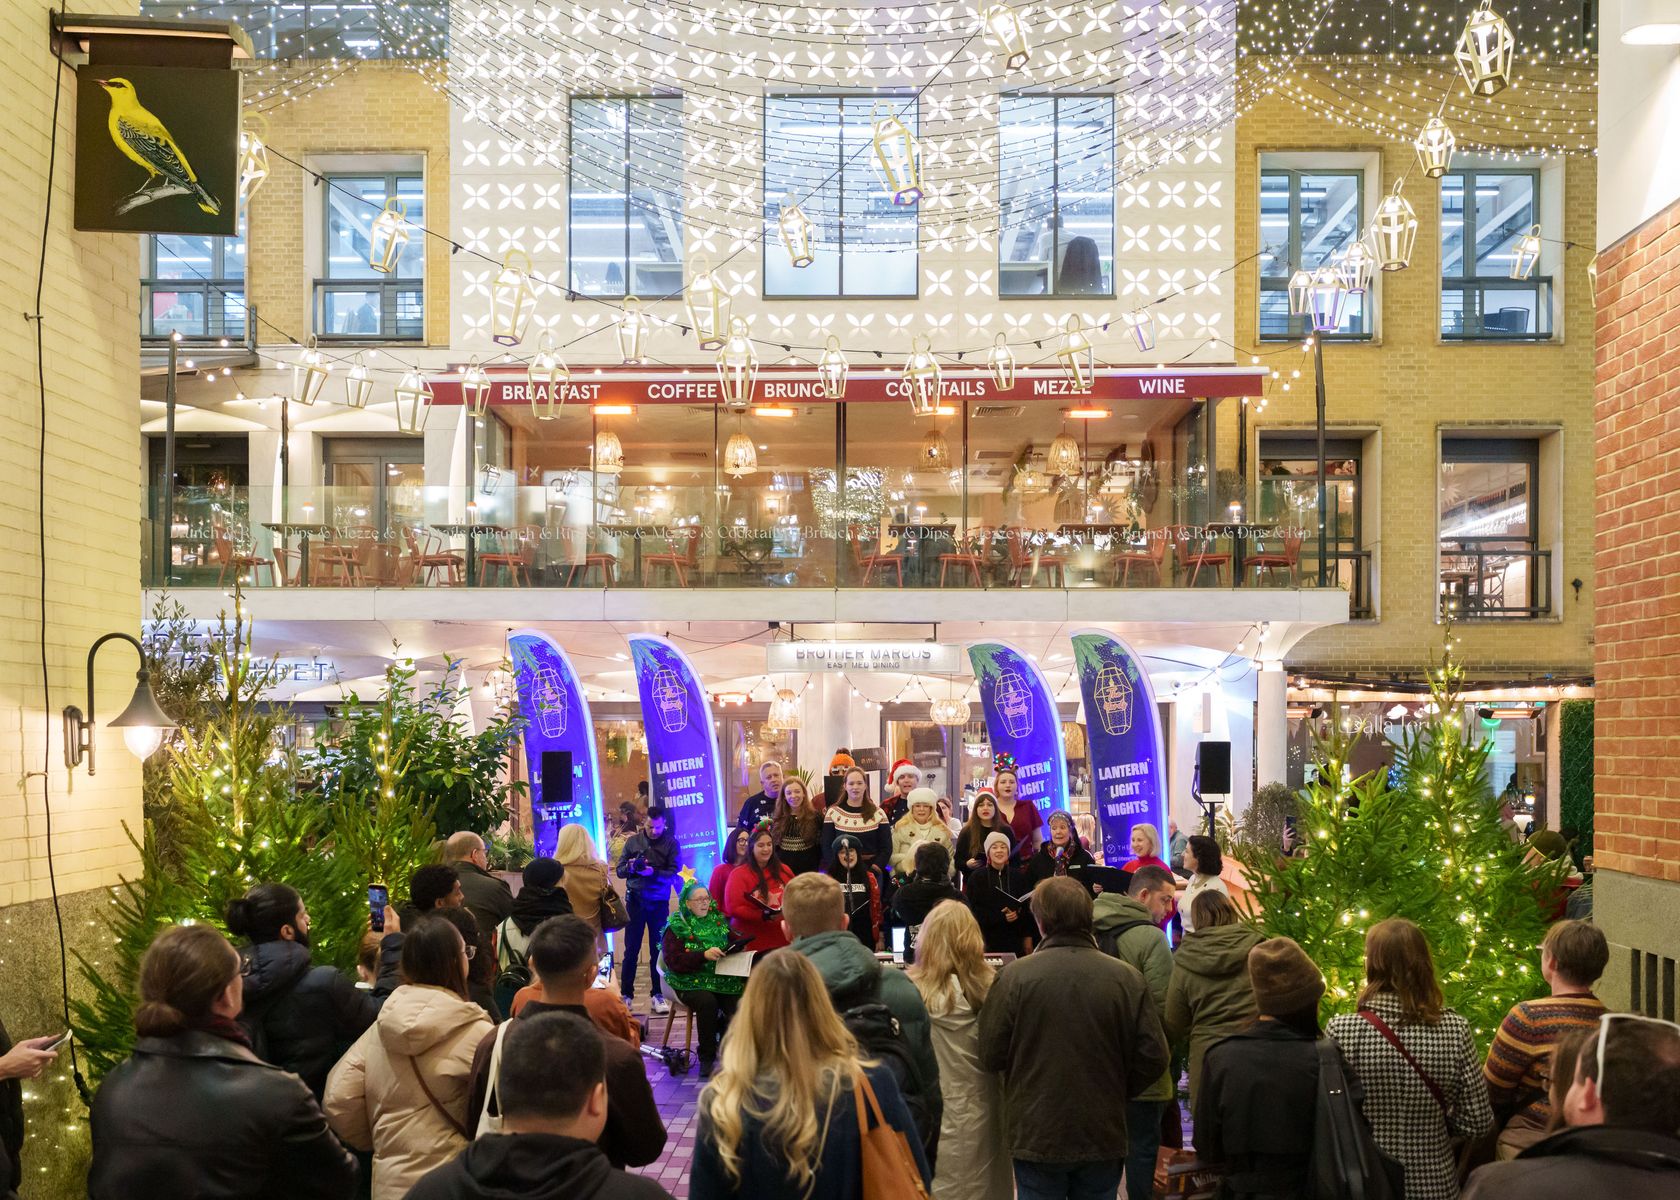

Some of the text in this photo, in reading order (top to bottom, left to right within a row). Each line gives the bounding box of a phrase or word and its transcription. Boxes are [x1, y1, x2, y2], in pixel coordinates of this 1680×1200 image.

[502, 384, 601, 400] BREAKFAST
[647, 383, 718, 399] COFFEE
[1033, 379, 1092, 395] MEZZE
[1138, 378, 1185, 394] WINE
[171, 526, 218, 539] unch
[318, 526, 330, 539] &
[335, 526, 379, 539] Mezze
[470, 526, 482, 539] &
[539, 526, 552, 539] &
[634, 526, 647, 539] &
[902, 526, 915, 539] &
[919, 526, 950, 542] Dips
[970, 526, 1015, 539] ezze
[1036, 526, 1102, 539] cktails
[1109, 526, 1121, 539] &
[1177, 526, 1191, 539] &
[1222, 526, 1234, 539] &
[1237, 526, 1268, 541] Dips
[1273, 526, 1285, 539] &
[1288, 526, 1312, 542] Rip
[870, 647, 932, 659] MARCUS
[827, 661, 848, 669] EAST
[656, 756, 704, 775] LANTERN
[1017, 760, 1051, 779] NTERN
[1098, 761, 1149, 781] LANTERN
[667, 775, 696, 792] LIGHT
[1110, 781, 1140, 799] LIGHT
[664, 791, 704, 809] NIGHTS
[1107, 799, 1149, 817] NIGHTS
